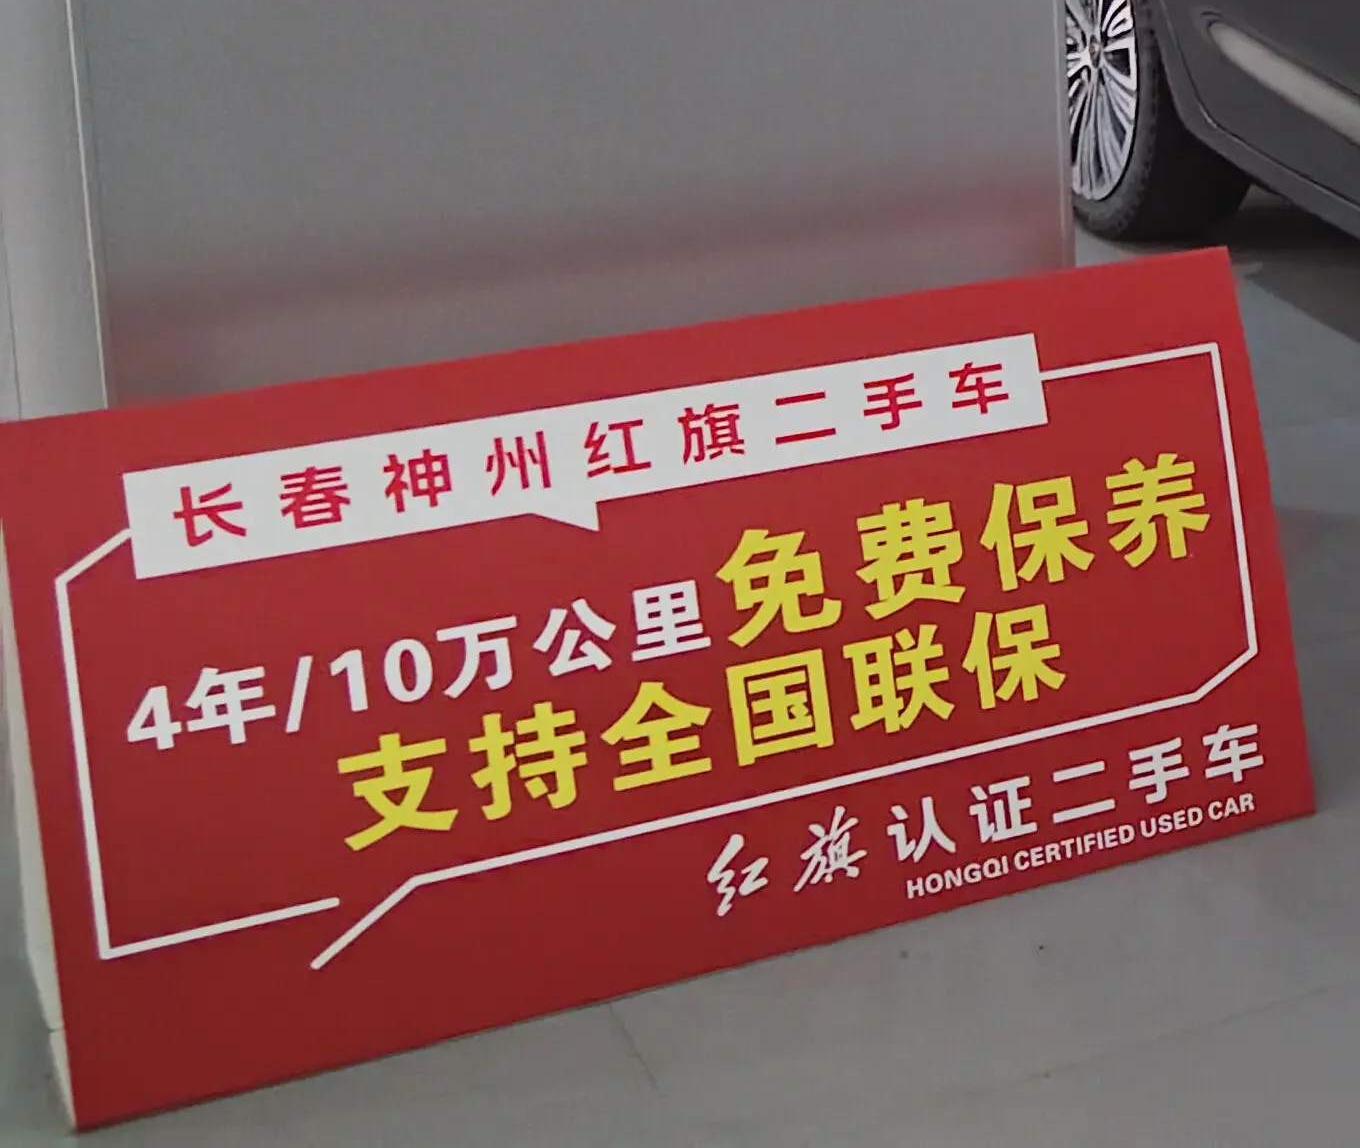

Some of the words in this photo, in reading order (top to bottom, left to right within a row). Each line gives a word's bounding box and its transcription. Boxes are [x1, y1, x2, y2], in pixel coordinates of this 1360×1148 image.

[172, 361, 1010, 547] 长春神州红旗二手车
[338, 605, 1067, 853] 支持全国联保
[706, 724, 1264, 918] 红旗认证二手车
[906, 855, 1009, 899] HONGQI
[1013, 823, 1135, 872] CERTIFIED
[1140, 806, 1203, 839] USED
[1207, 792, 1256, 822] CAR
